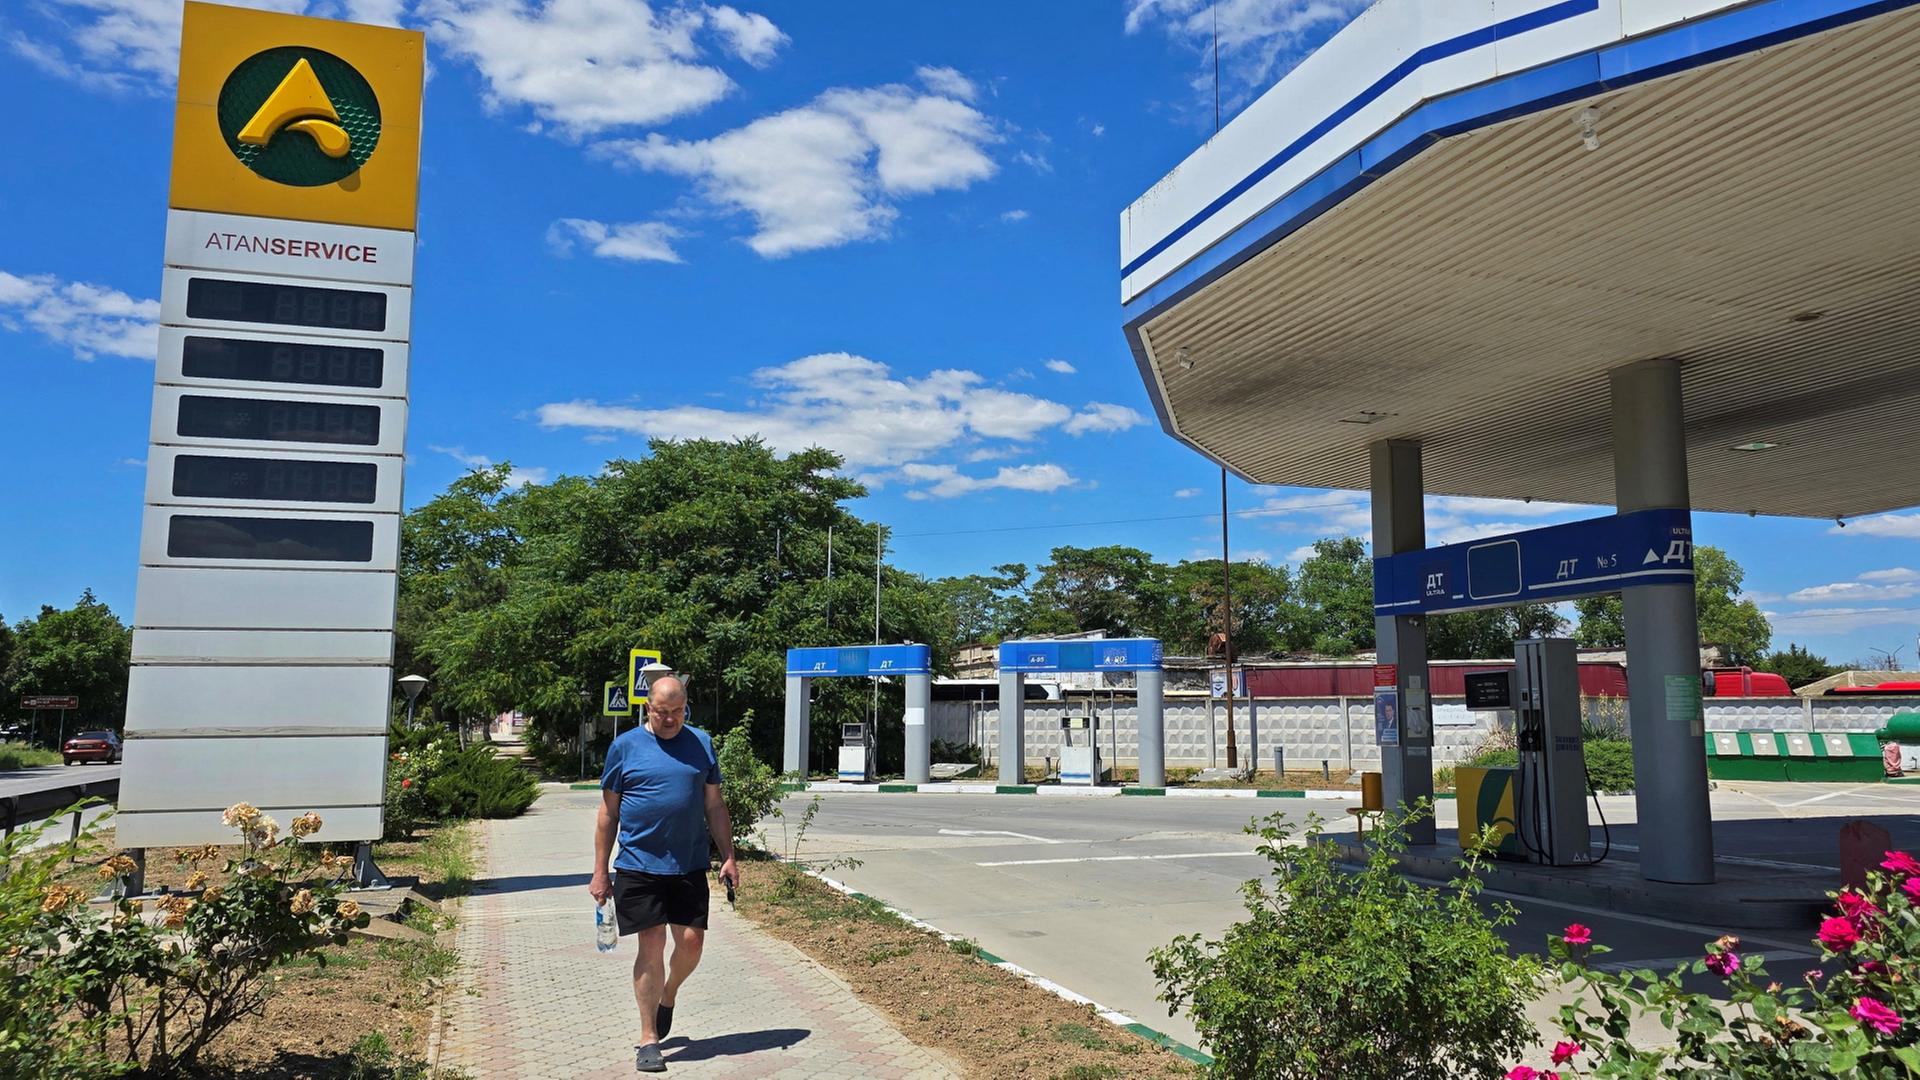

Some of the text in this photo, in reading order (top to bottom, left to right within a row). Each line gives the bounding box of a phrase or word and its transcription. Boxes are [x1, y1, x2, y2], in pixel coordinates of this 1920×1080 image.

[205, 232, 377, 263] ATANSERVICE
[1556, 553, 1617, 580] ДТ № 5
[1426, 573, 1444, 590] ДТ
[813, 662, 827, 671] ДТ
[880, 660, 893, 669] ДТ
